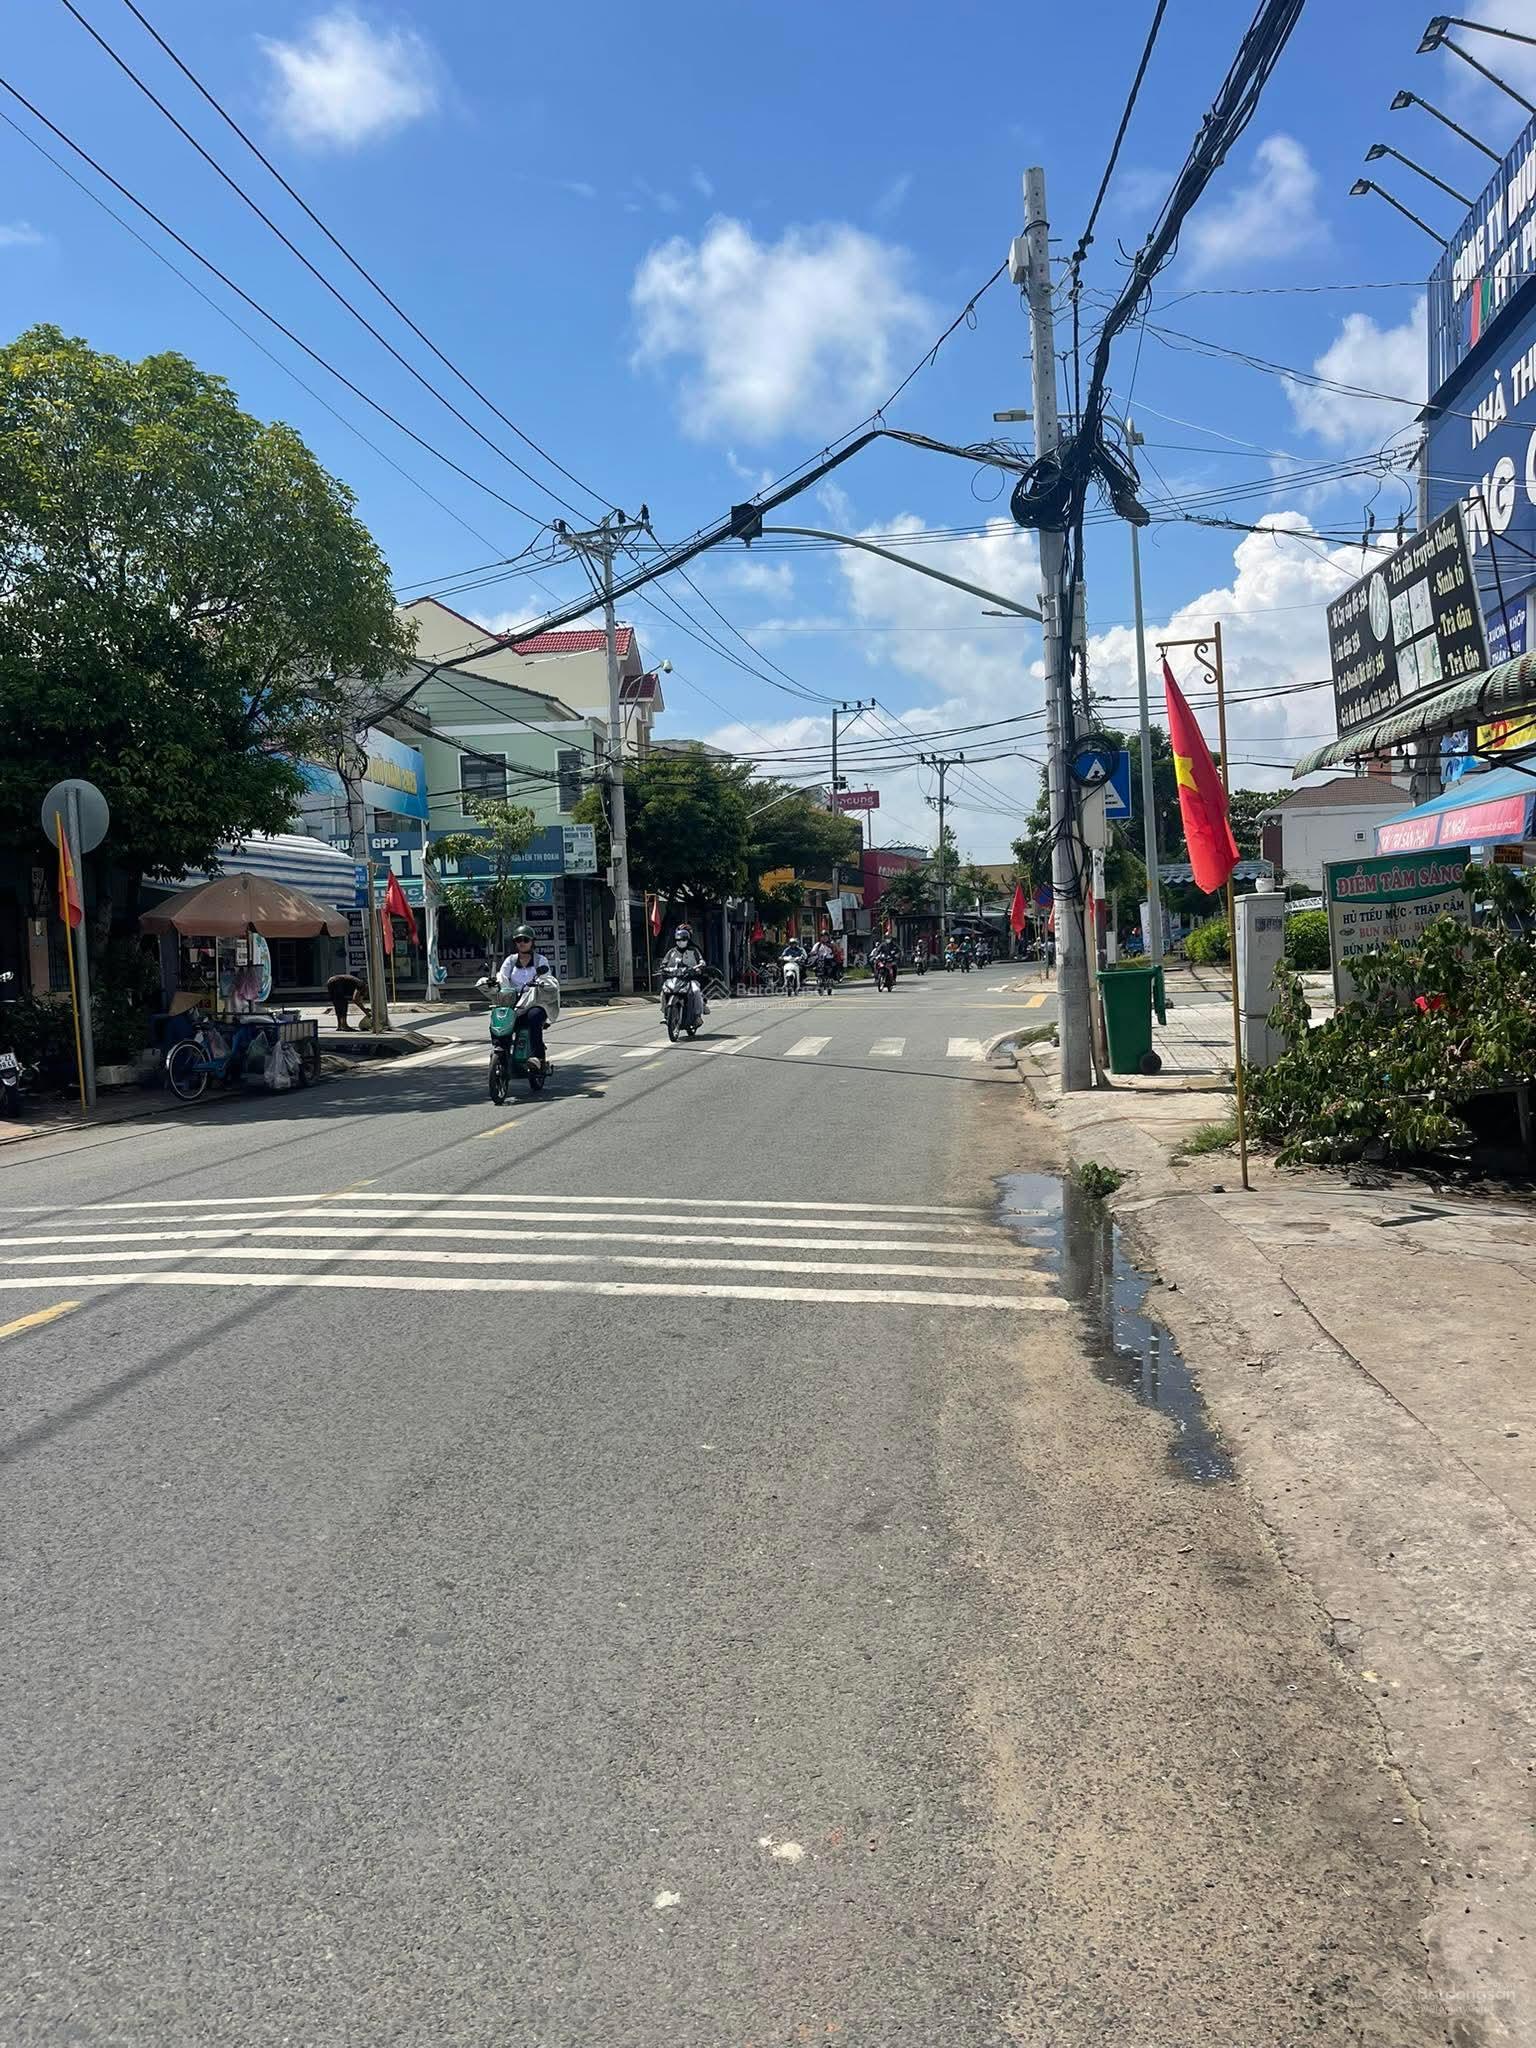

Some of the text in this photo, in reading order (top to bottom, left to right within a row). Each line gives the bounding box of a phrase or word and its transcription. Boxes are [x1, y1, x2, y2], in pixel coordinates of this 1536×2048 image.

[1453, 224, 1485, 303] CÔNG
[1487, 194, 1504, 256] TY
[1472, 368, 1507, 450] NHÀ
[1391, 557, 1403, 585] Trà
[1436, 566, 1456, 596] Sinh
[1440, 608, 1456, 637] Trà
[1448, 650, 1464, 676] Trà
[371, 838, 399, 849] GPP
[1337, 861, 1464, 898] ĐIỂM TÂM SÁNG
[1343, 909, 1357, 925] HỦ
[1358, 906, 1383, 923] TIẾU
[1413, 901, 1442, 917] THẬP
[1343, 942, 1363, 956] BÚN
